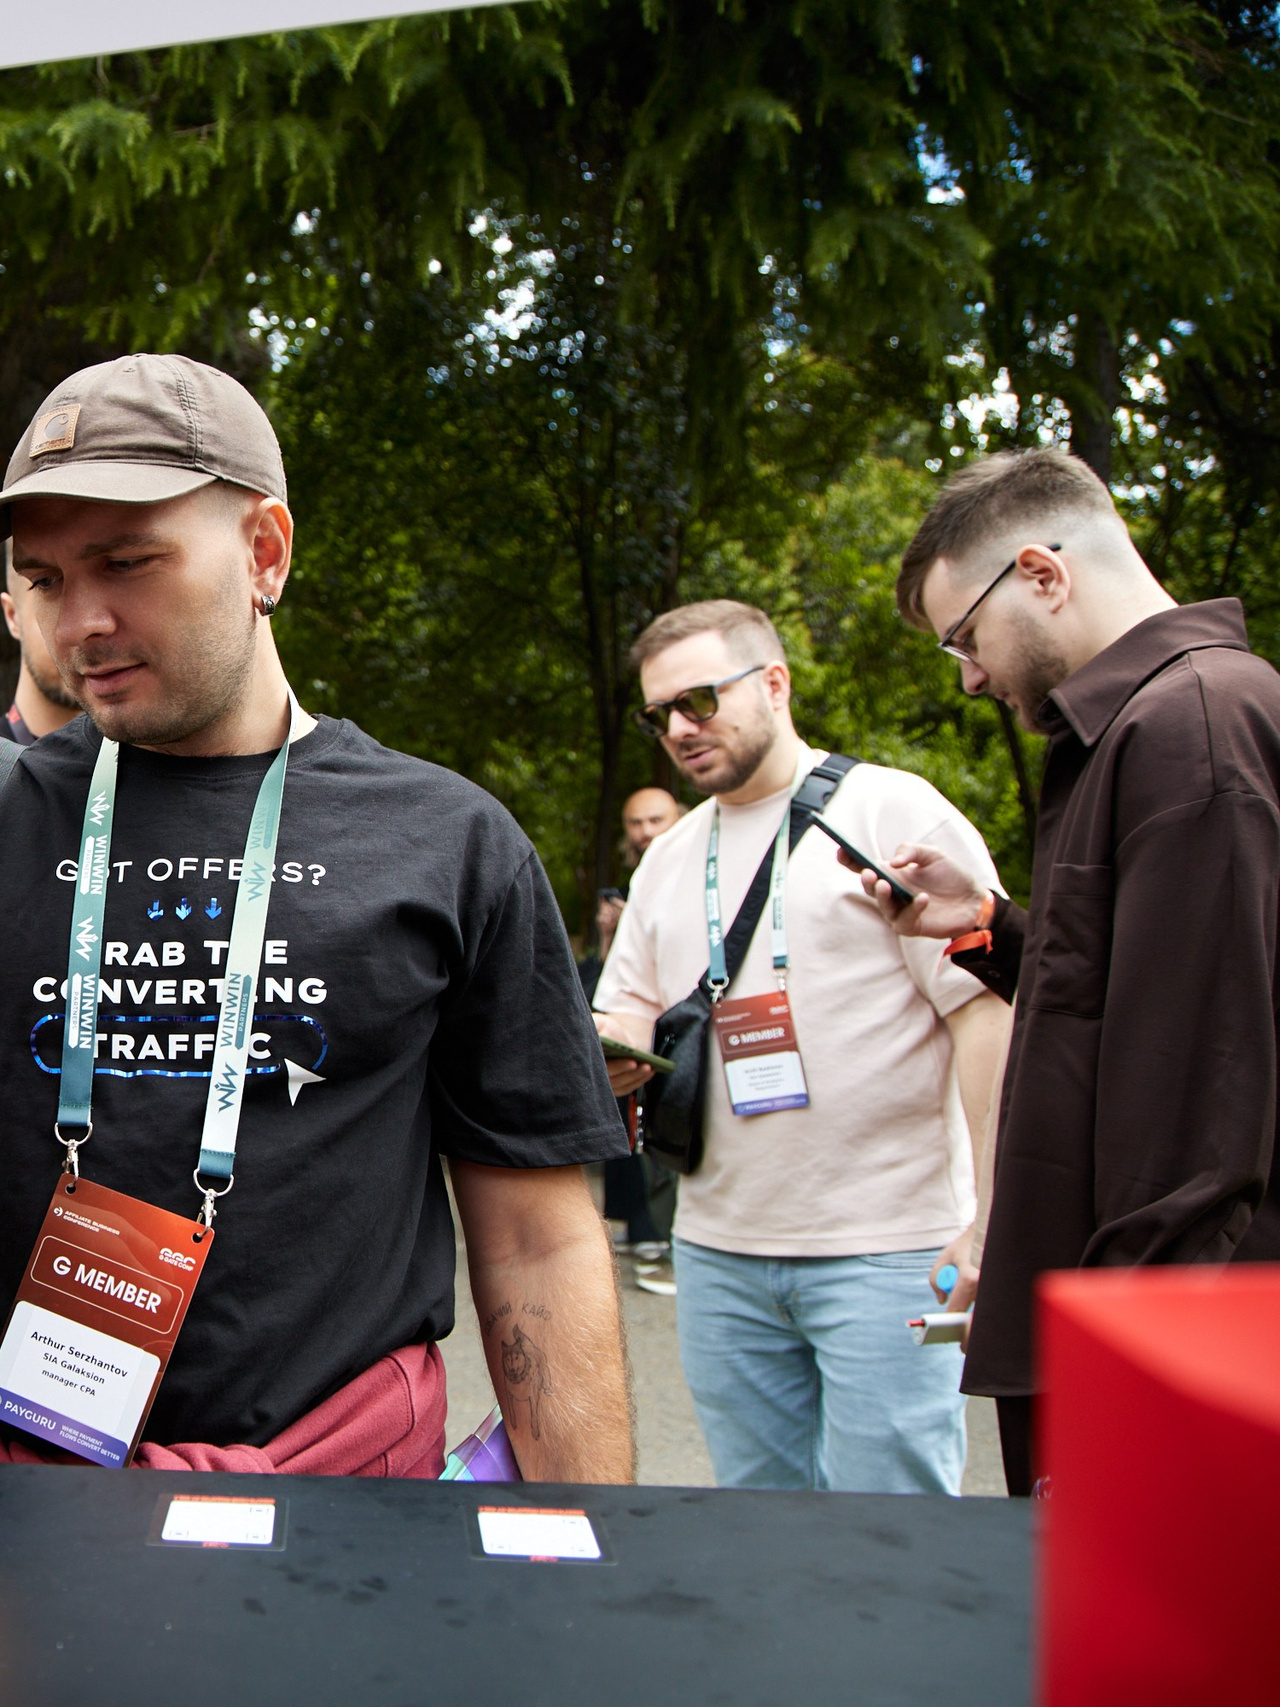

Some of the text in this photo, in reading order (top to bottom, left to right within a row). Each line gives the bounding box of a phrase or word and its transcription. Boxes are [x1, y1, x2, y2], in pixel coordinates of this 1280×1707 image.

[55, 857, 326, 886] GT OFFES?
[90, 834, 108, 895] WINWIN
[104, 940, 288, 967] RAB TE
[32, 976, 328, 1005] CNVERTNG
[79, 973, 96, 1049] WINWIN
[220, 972, 242, 1048] WINWIN
[238, 993, 249, 1032] PARTNERS
[93, 1032, 272, 1060] TRAFFC
[740, 1027, 785, 1044] MEMBER
[53, 1255, 162, 1314] G MEMBER
[30, 1331, 128, 1378] Arthur Serzhantov
[42, 1352, 105, 1384] SIA Galaksion
[41, 1369, 96, 1396] manager CPA
[4, 1401, 57, 1431] PAYGURU
[59, 1430, 121, 1462] FLOWS CONVERT BETTER
[61, 1425, 104, 1447] WHERE PAYMENT
